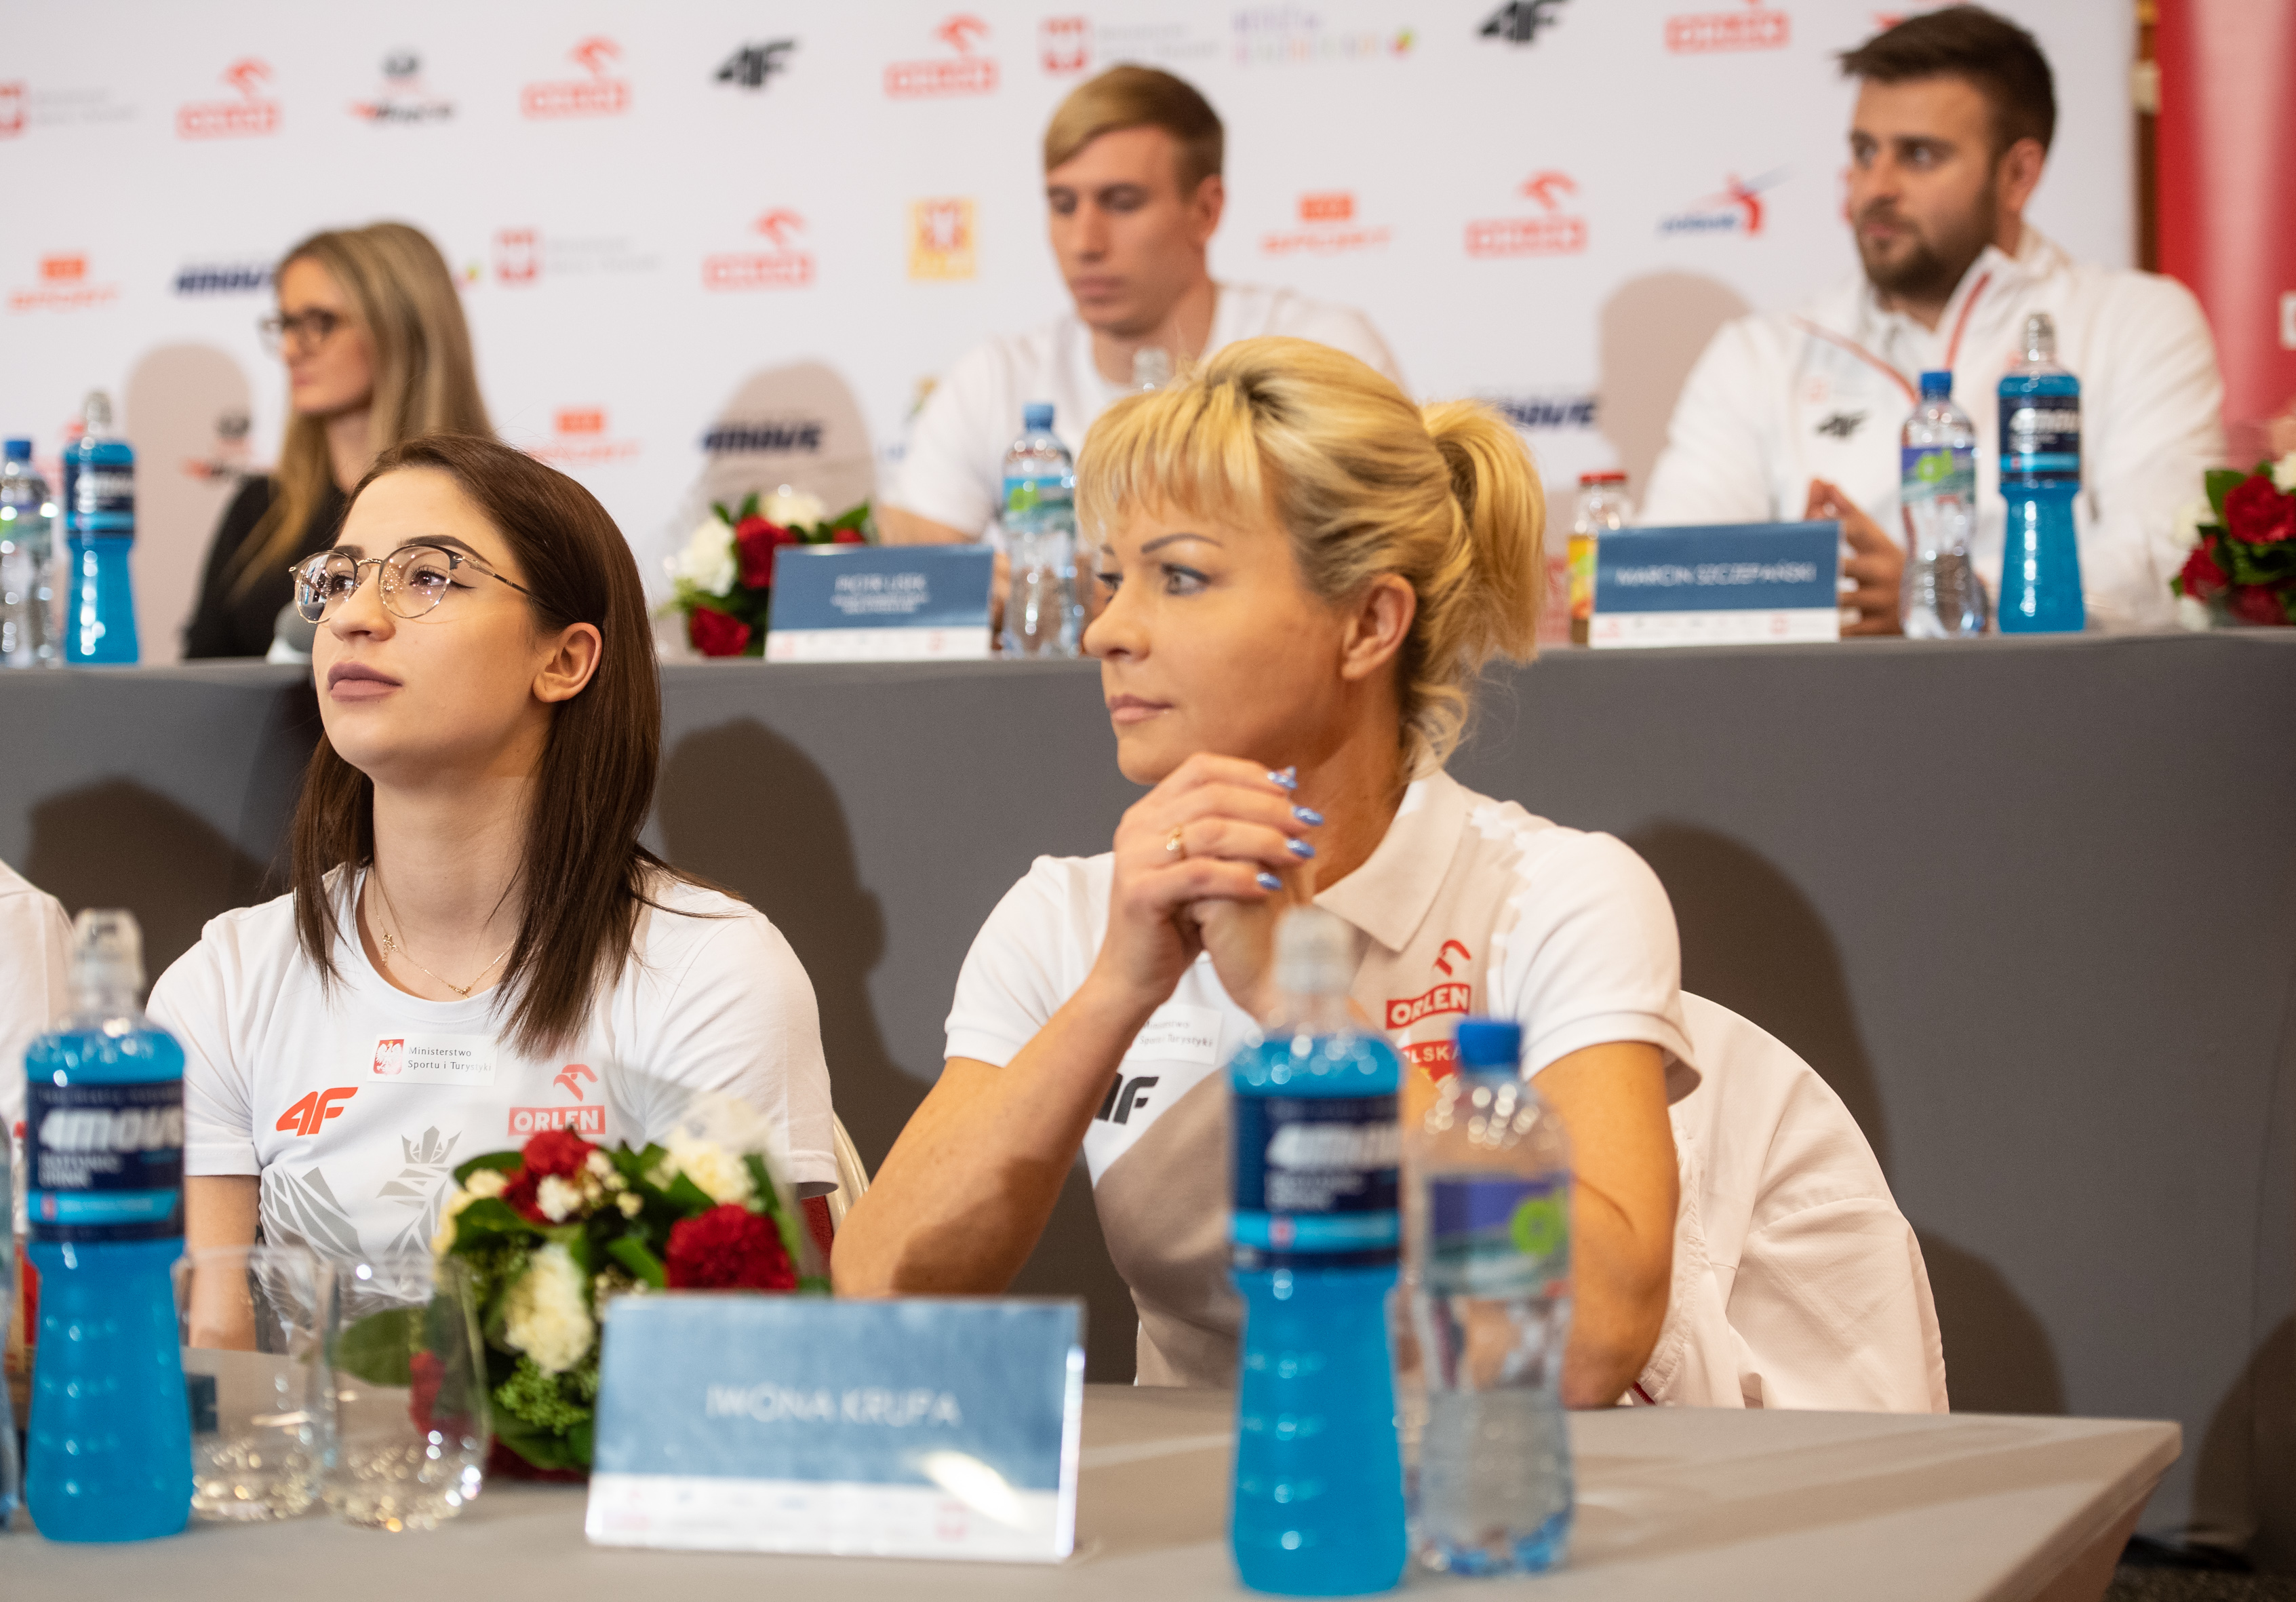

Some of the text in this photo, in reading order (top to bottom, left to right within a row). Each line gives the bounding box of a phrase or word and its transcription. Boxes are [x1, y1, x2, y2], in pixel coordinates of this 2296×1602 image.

[712, 38, 797, 90] 4F
[409, 1047, 472, 1057] Ministerstwo
[408, 1059, 492, 1072] Sportu i Turystyki
[275, 1087, 359, 1137] 4F
[513, 1110, 599, 1132] ORLEN
